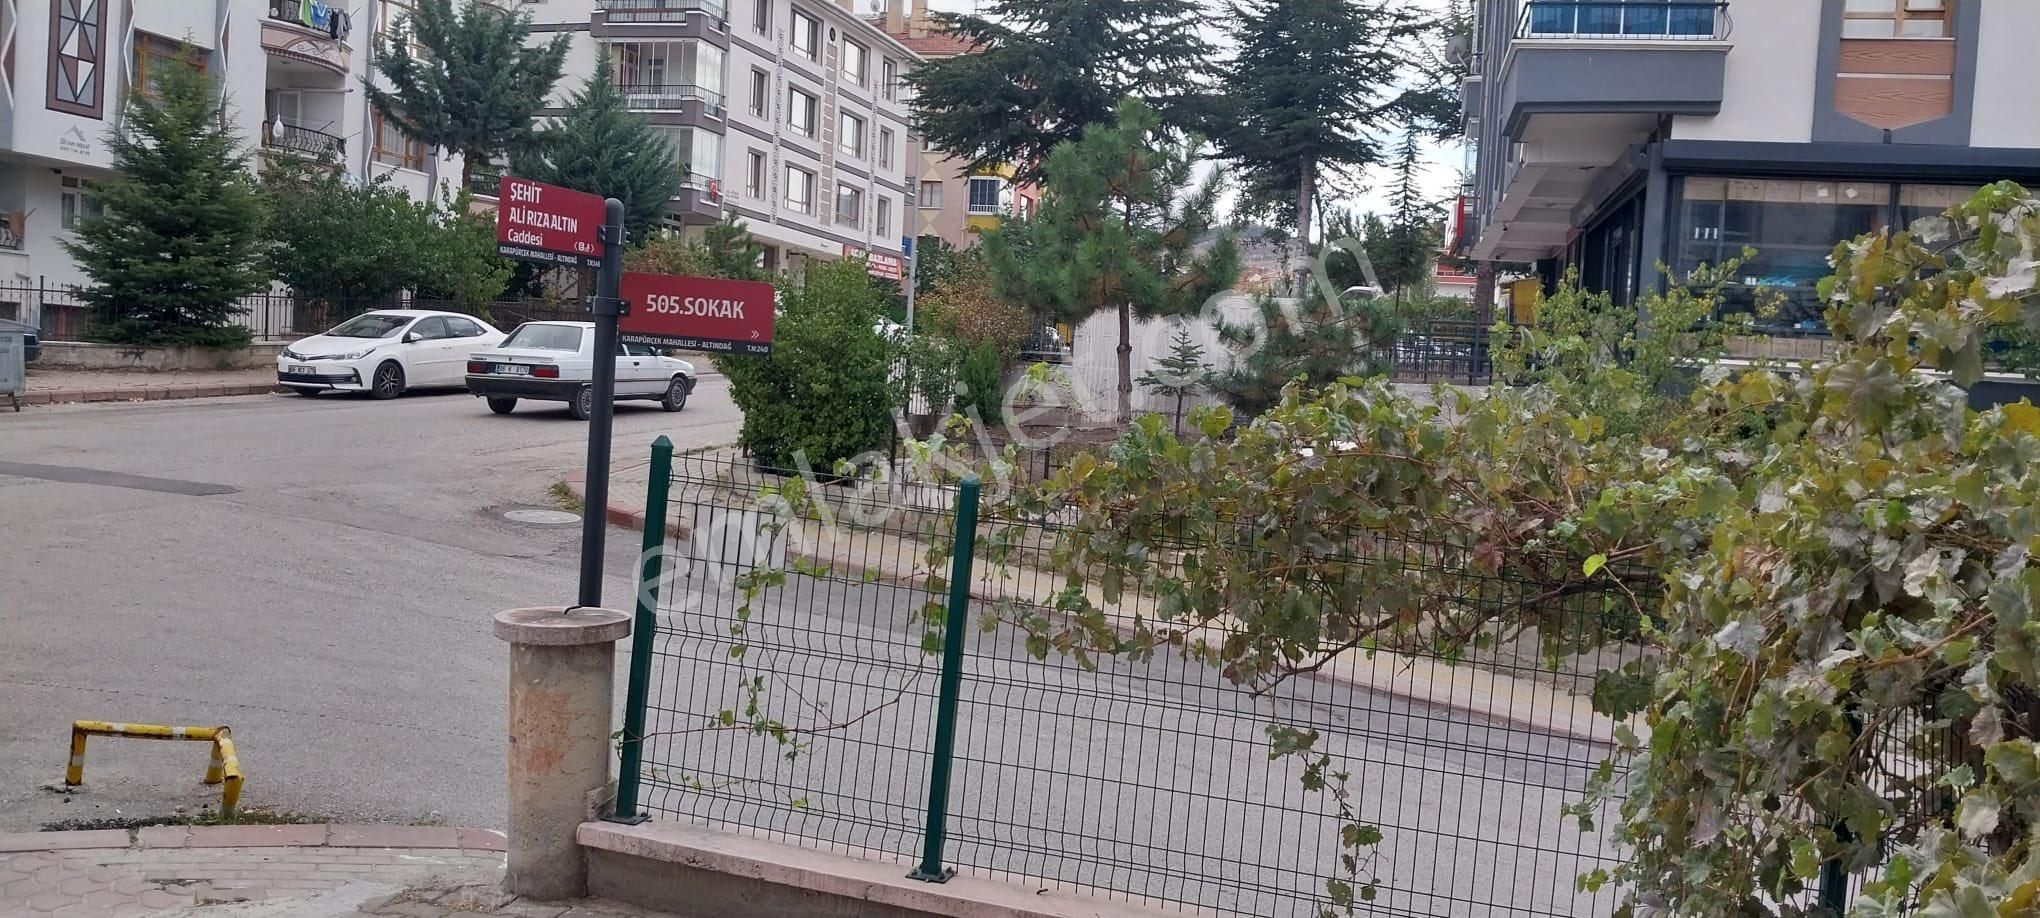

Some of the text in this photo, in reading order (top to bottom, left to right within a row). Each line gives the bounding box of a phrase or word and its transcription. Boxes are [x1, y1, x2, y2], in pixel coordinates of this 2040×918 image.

[510, 181, 542, 204] ŞEHİT
[509, 205, 578, 233] ALİ RIZA ALTIN
[508, 228, 543, 246] Caddesi
[499, 246, 530, 257] KARAPÜRÇEK
[557, 254, 578, 264] ALTINDAĞ
[646, 294, 745, 320] 505.SOKAK
[622, 334, 662, 345] KARAPÜRÇEK
[662, 338, 697, 348] MAHALLESİ
[702, 341, 732, 351] ALTINDAĞ
